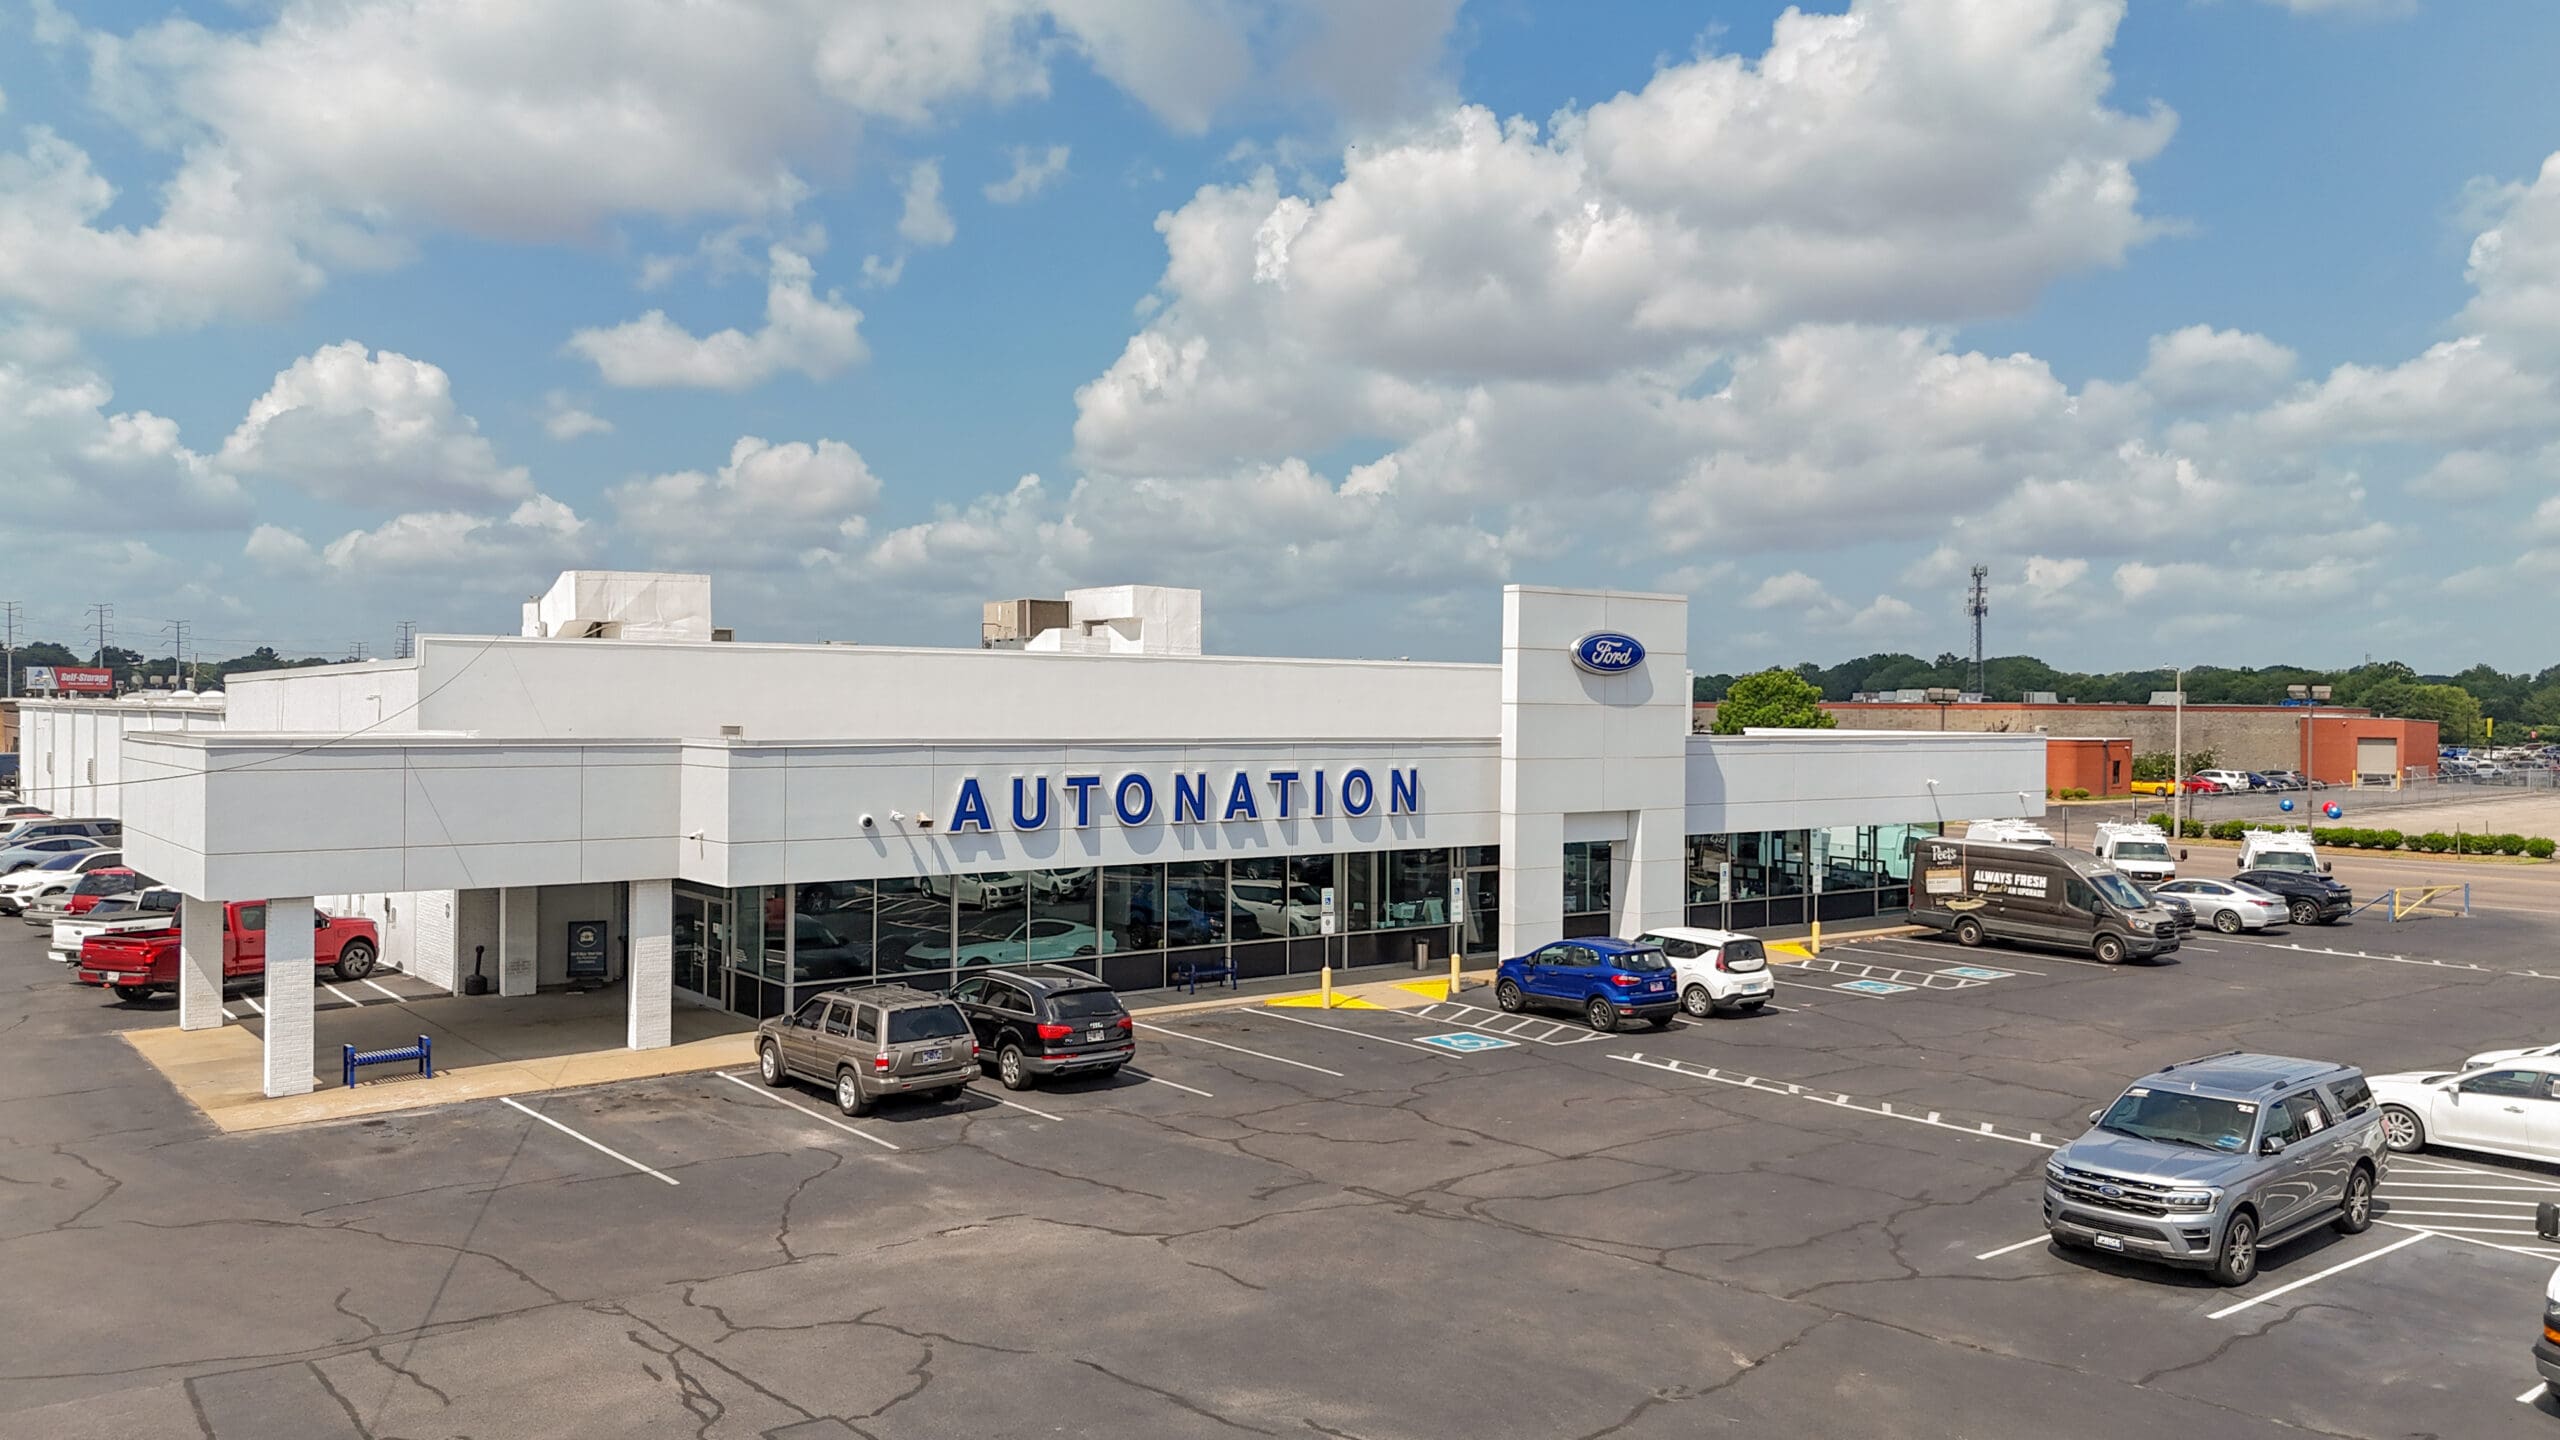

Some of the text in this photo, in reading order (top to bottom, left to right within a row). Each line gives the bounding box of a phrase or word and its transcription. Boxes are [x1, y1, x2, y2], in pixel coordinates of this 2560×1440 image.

[1592, 640, 1632, 664] Ford
[61, 672, 109, 682] Self-Storage
[946, 768, 1419, 834] AUTONATION
[1973, 870, 2048, 888] ALWAYS FRESH
